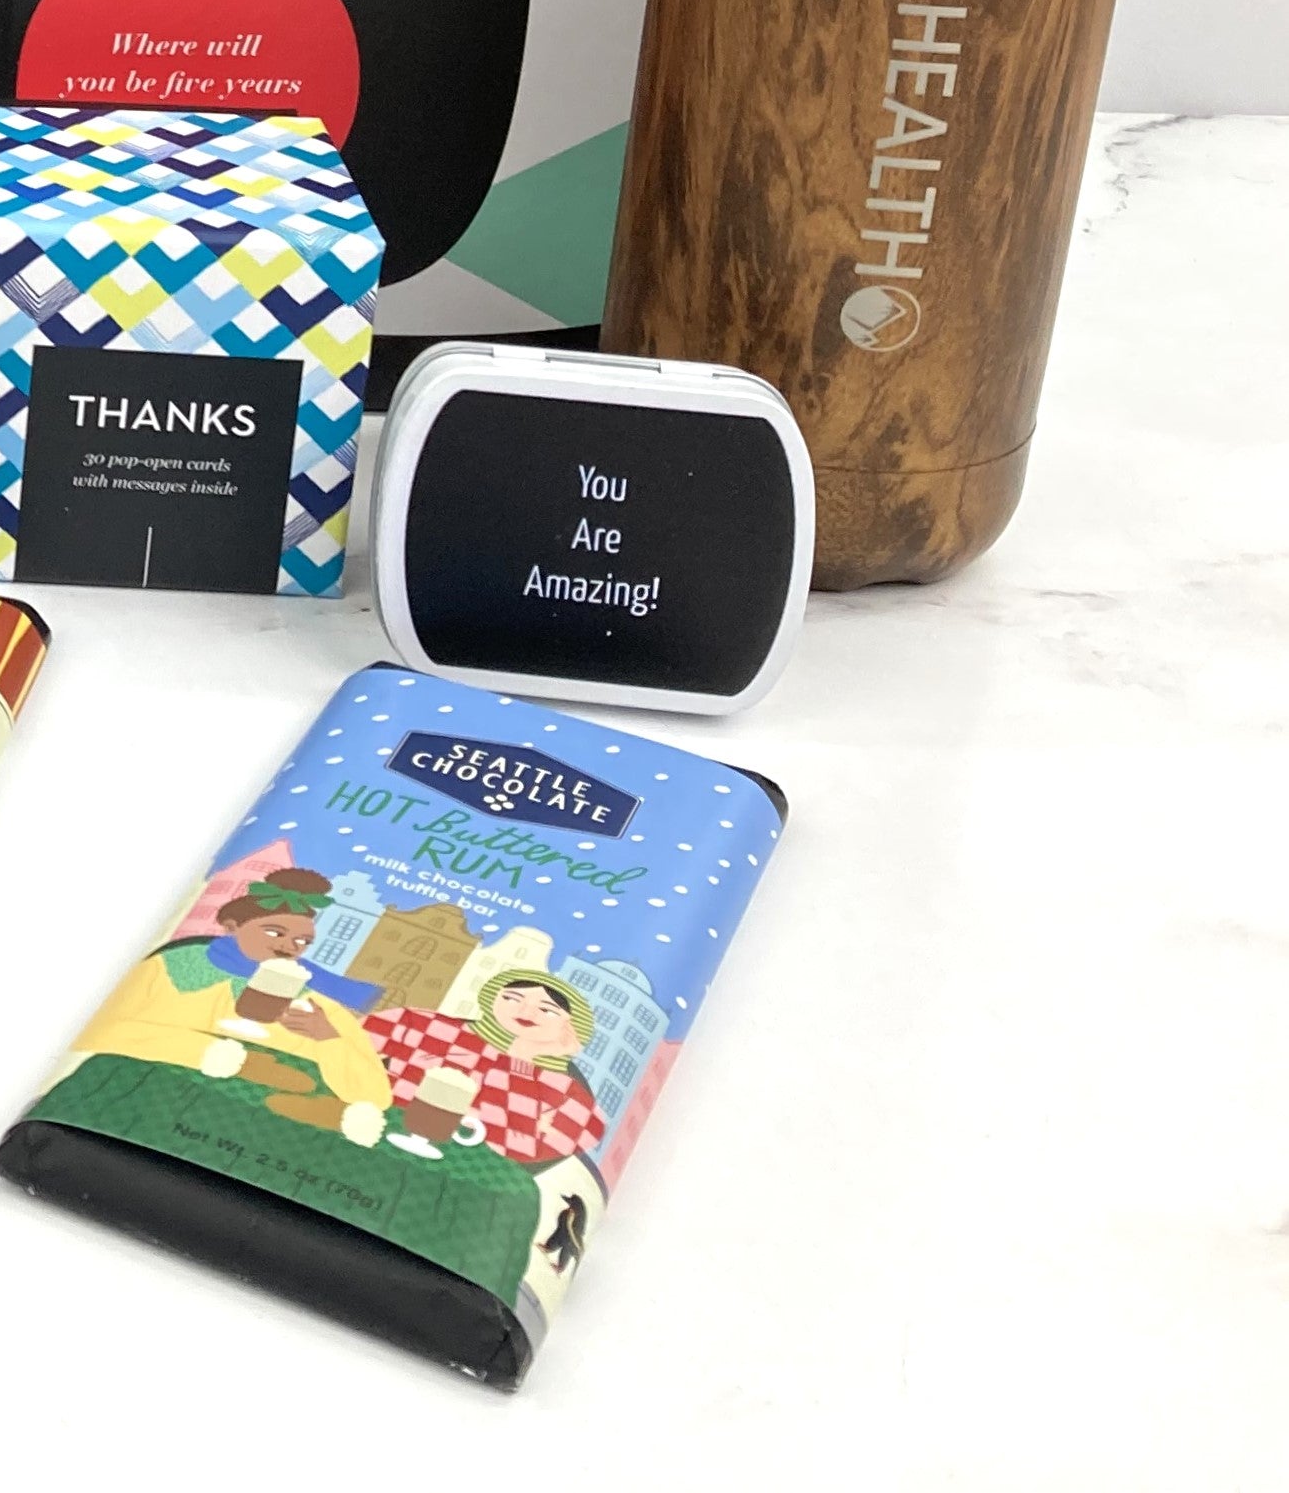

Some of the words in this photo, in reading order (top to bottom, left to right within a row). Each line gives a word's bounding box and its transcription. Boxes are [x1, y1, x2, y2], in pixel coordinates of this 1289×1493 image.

[111, 32, 198, 58] Where
[206, 33, 263, 59] will
[57, 73, 117, 99] you
[124, 71, 158, 94] be
[158, 70, 219, 101] five
[217, 75, 303, 101] years
[68, 393, 258, 438] THANKS
[72, 473, 109, 490] with
[112, 477, 187, 496] messages
[190, 479, 239, 497] inside
[82, 451, 107, 468] 30
[107, 455, 184, 475] pop-open
[186, 456, 232, 474] cards
[578, 464, 629, 503] You
[570, 517, 622, 555] Are
[523, 564, 662, 617] Amazing!
[411, 751, 612, 825] CHOCOLATE
[448, 742, 593, 799] SEATTLE
[324, 779, 431, 825] HOT
[412, 808, 649, 896] Buttered
[363, 852, 413, 876] milk
[418, 870, 538, 916] chocolate
[412, 834, 525, 891] RUM
[385, 874, 452, 904] truffle
[456, 895, 500, 919] bar
